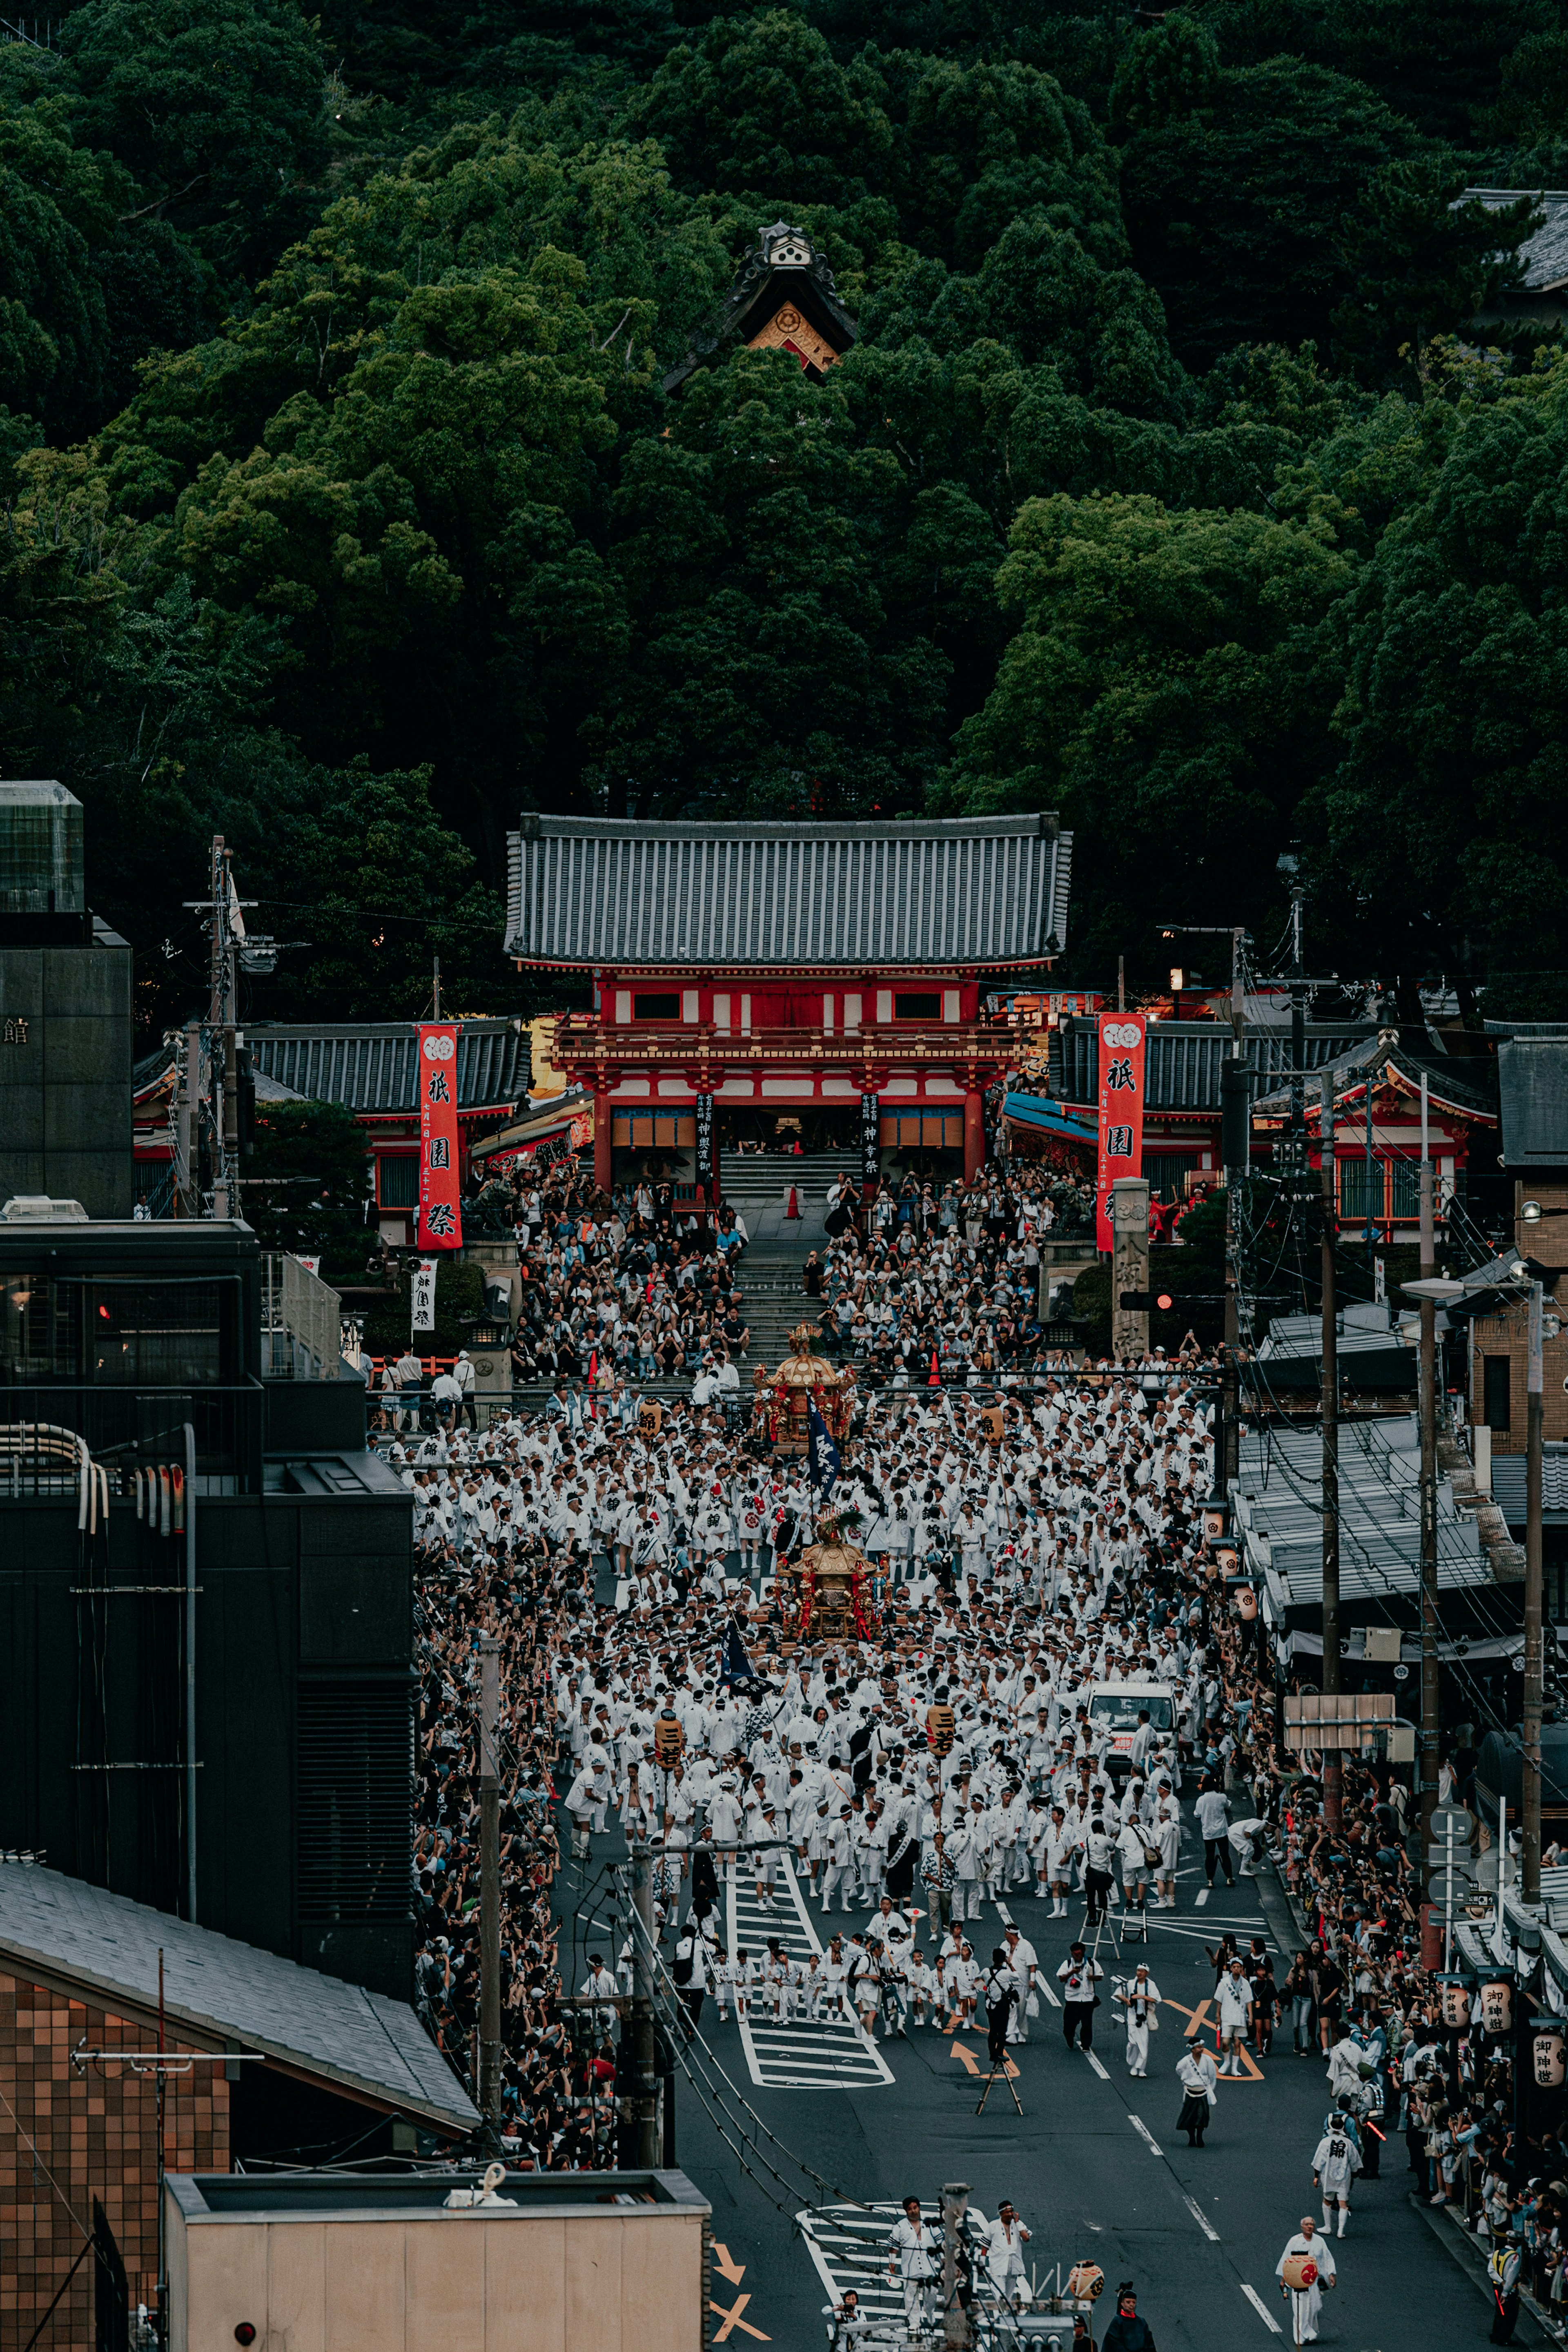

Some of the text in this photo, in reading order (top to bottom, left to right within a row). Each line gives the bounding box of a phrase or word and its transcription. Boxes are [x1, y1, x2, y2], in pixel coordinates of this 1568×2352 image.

[3, 1018, 29, 1044] 館
[427, 1070, 455, 1236] 祇園祭
[864, 1126, 878, 1173] 神幸祭
[742, 1495, 755, 1509] 錦
[526, 1510, 539, 1524] 錦
[707, 1514, 720, 1527] 錦
[895, 1507, 907, 1521] 錦
